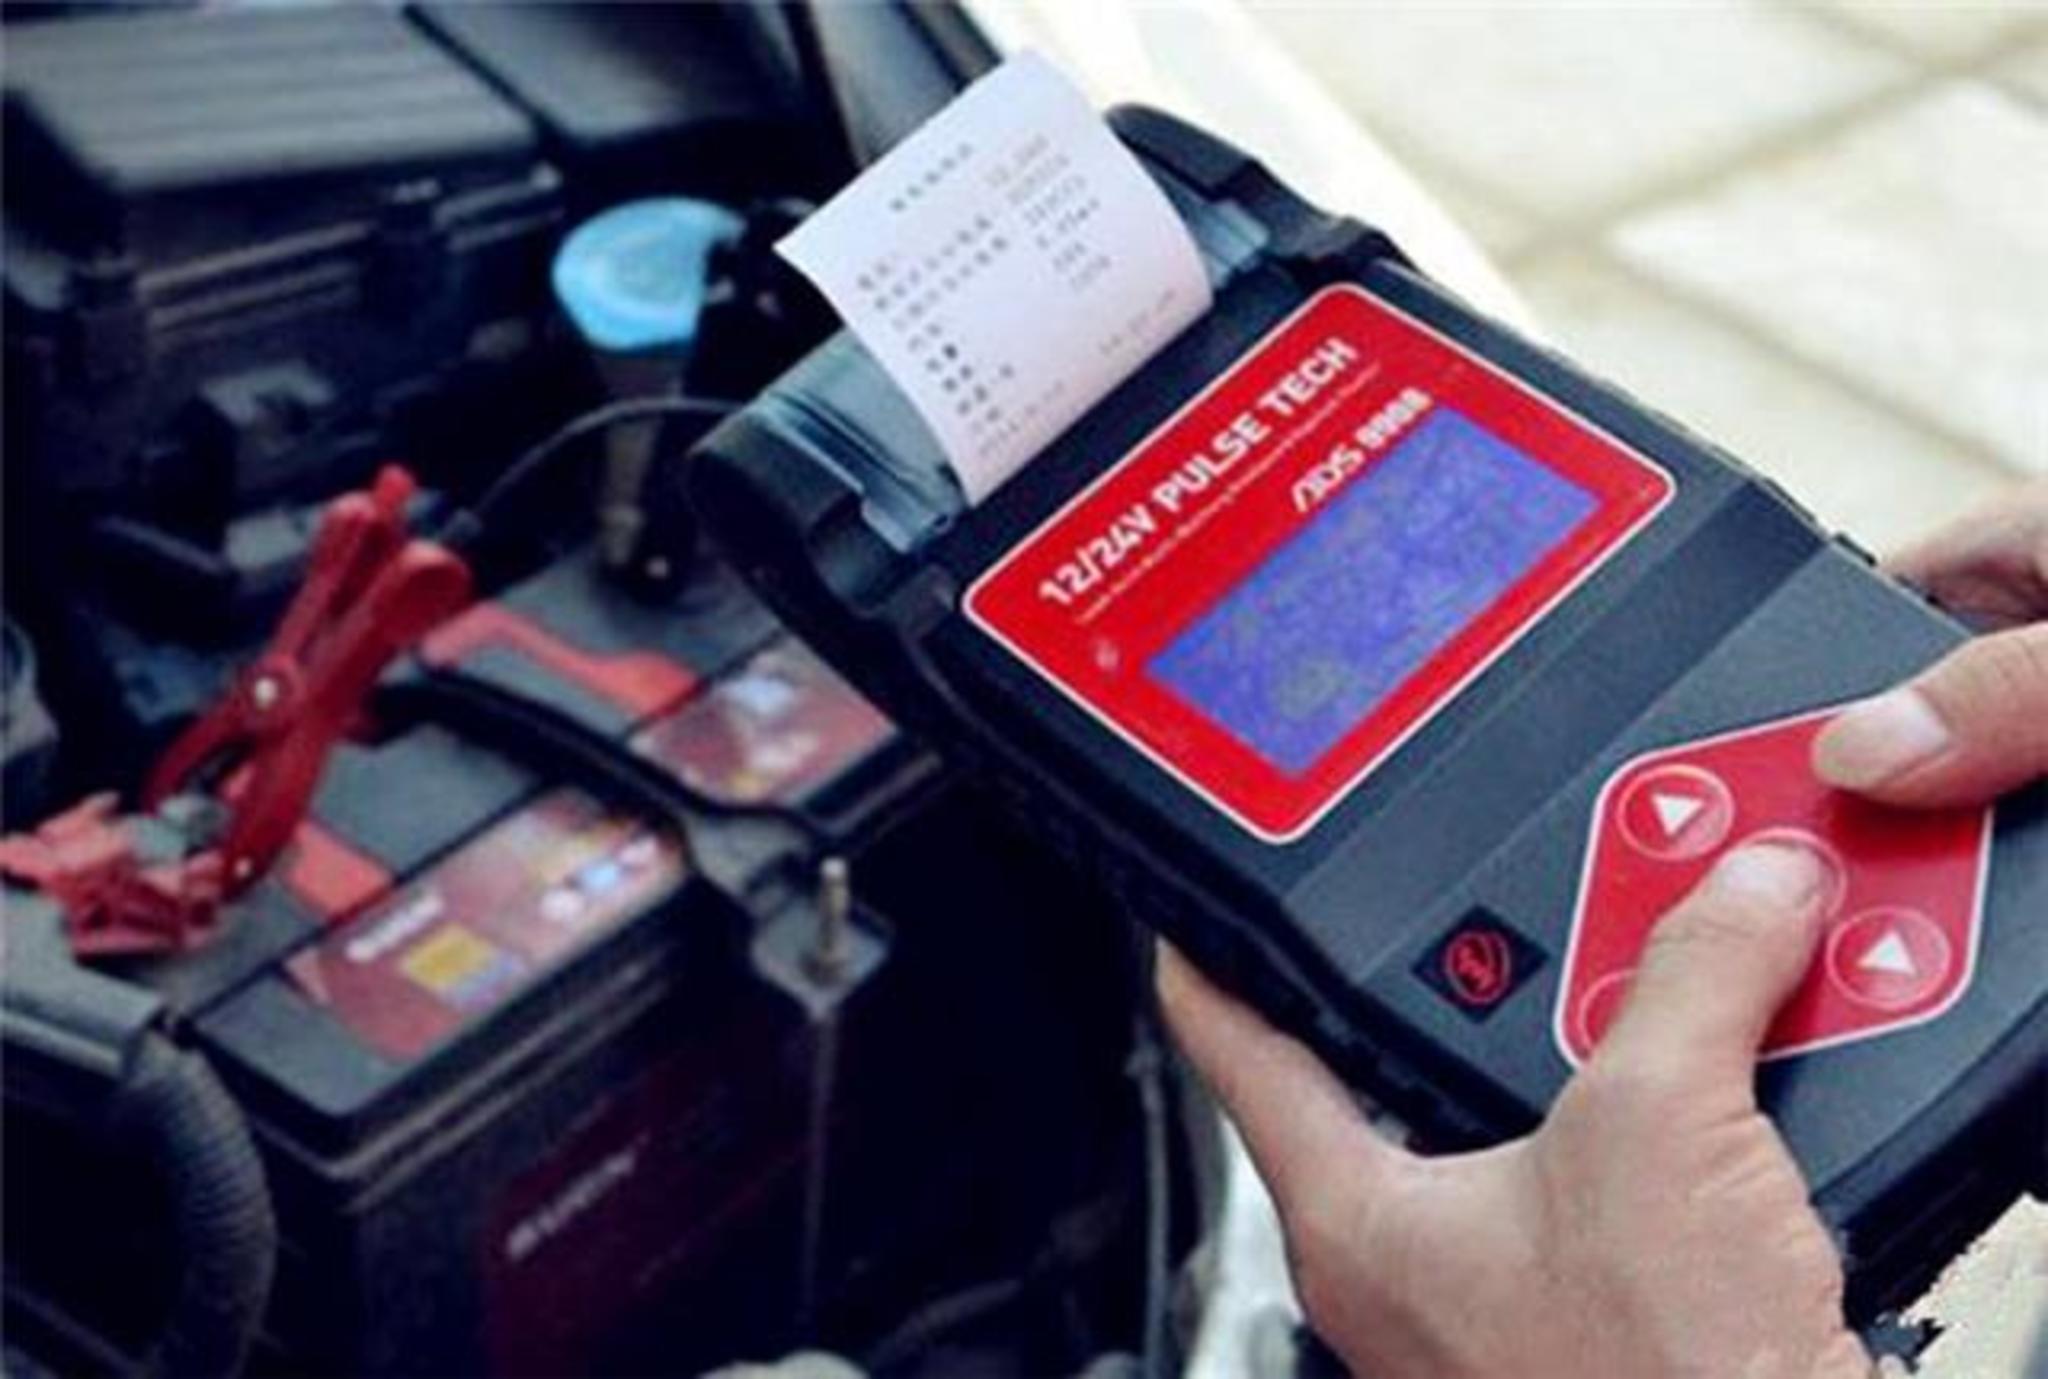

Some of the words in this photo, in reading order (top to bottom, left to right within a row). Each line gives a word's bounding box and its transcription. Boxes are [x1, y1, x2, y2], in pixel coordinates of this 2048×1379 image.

[1038, 503, 1157, 606] 12/24V
[1151, 411, 1273, 513] PULSE
[1256, 336, 1358, 418] TECH
